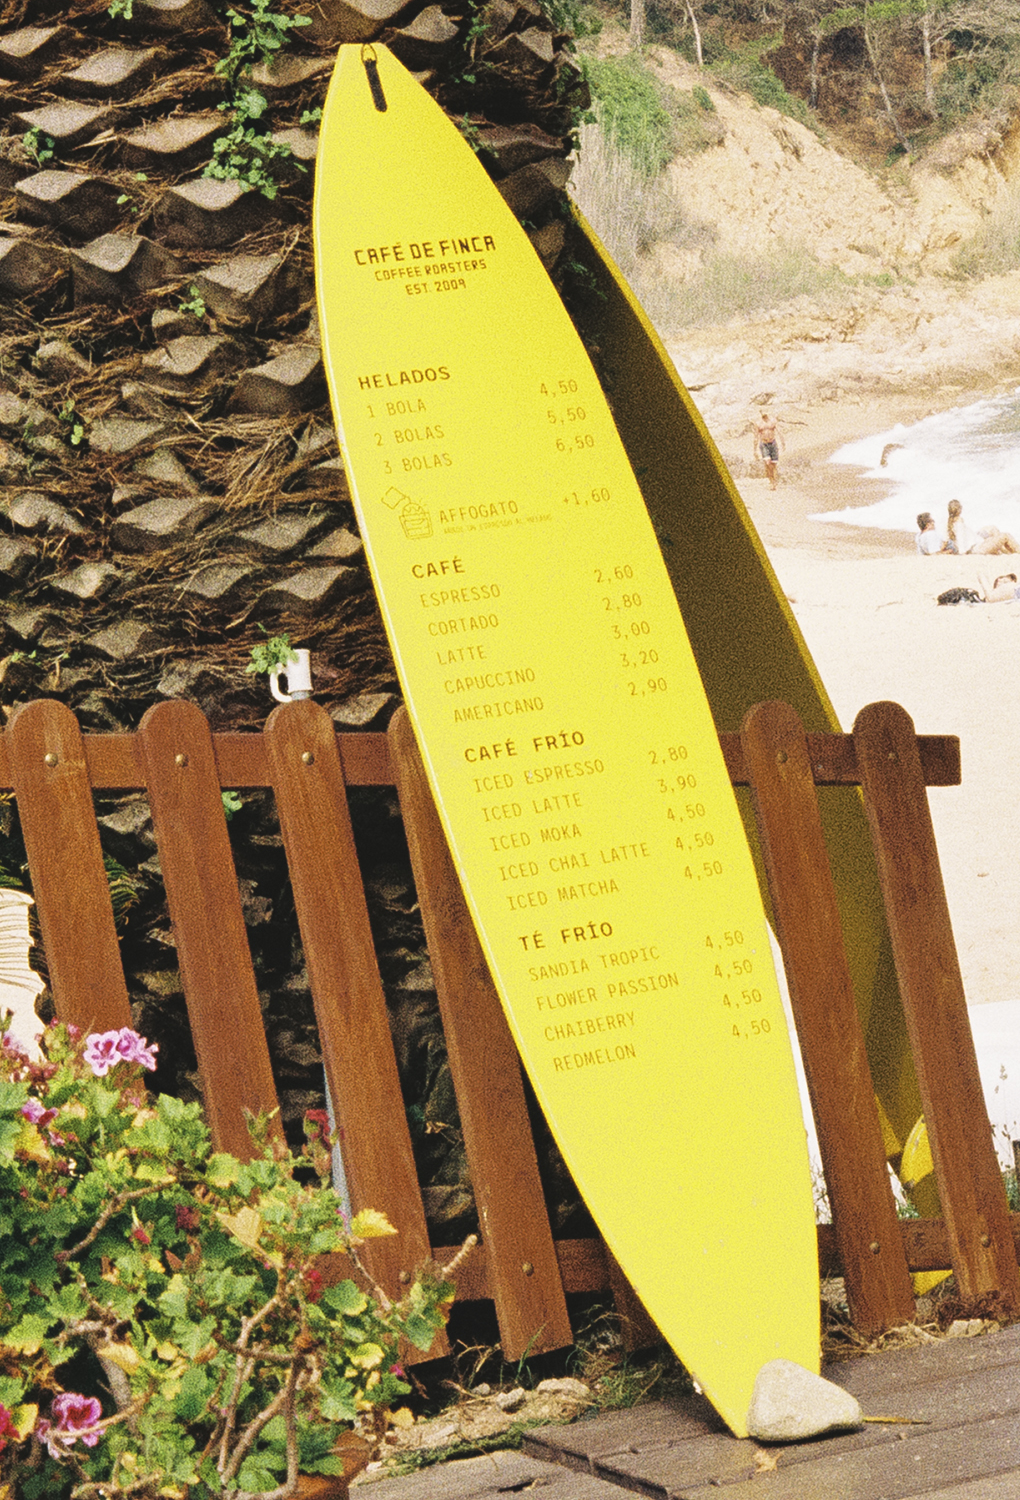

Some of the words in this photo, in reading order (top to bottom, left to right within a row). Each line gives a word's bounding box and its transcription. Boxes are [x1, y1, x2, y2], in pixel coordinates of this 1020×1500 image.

[354, 242, 406, 266] CAFÉ
[409, 242, 435, 259] DE
[439, 235, 496, 257] FINCA
[374, 265, 422, 282] COFFEE
[425, 259, 488, 275] ROASTERS
[435, 278, 467, 292] 2009
[358, 366, 451, 390] HELADOS
[368, 404, 375, 418] 1
[386, 399, 427, 416] BOLA
[539, 379, 579, 398] 4,50
[375, 432, 383, 446] 2
[394, 425, 445, 444] BOLAS
[547, 407, 587, 424] 5,50
[384, 461, 392, 474] 3
[402, 453, 453, 472] BOLAS
[556, 435, 595, 452] 6,50
[439, 500, 519, 524] AFFOGATO
[563, 488, 611, 506] +1,60
[412, 557, 466, 579] CAFÉ
[420, 583, 501, 608] ESPRESSO
[594, 565, 634, 583] 2,60
[428, 614, 499, 637] CORTADO
[602, 593, 642, 611] 2,80
[437, 645, 488, 666] LATTE
[611, 621, 651, 639] 3,00
[444, 668, 536, 695] CAPUCCINO
[620, 649, 659, 668] 3,20
[453, 697, 544, 723] AMERICANO
[628, 678, 668, 696] 2,90
[465, 740, 518, 763] CAFÉ
[533, 730, 585, 752] FRÍO
[474, 774, 514, 793] ICED
[524, 759, 605, 785] ESPRESSO
[648, 746, 688, 765] 2,80
[482, 804, 522, 822] ICED
[533, 793, 583, 814] LATTE
[658, 774, 697, 794] 3,90
[490, 832, 531, 852] ICED
[541, 824, 582, 842] MOKA
[667, 803, 706, 822] 4,50
[499, 862, 539, 881] ICED
[549, 853, 591, 872] CHAI
[600, 843, 651, 865] LATTE
[675, 832, 715, 851] 4,50
[507, 891, 548, 911] ICED
[558, 878, 620, 901] MATCHA
[683, 861, 723, 881] 4,50
[518, 931, 546, 951] TÉ
[560, 922, 614, 945] FRÍO
[528, 960, 590, 982] SANDIA
[599, 946, 661, 969] TROPIC
[705, 930, 744, 950] 4,50
[536, 988, 599, 1011] FLOWER
[608, 972, 680, 999] PASSION
[714, 959, 753, 979] 4,50
[544, 1011, 636, 1042] CHAIBERRY
[722, 988, 762, 1009] 4,50
[553, 1044, 637, 1072] REDMELON
[731, 1018, 771, 1039] 4,50
